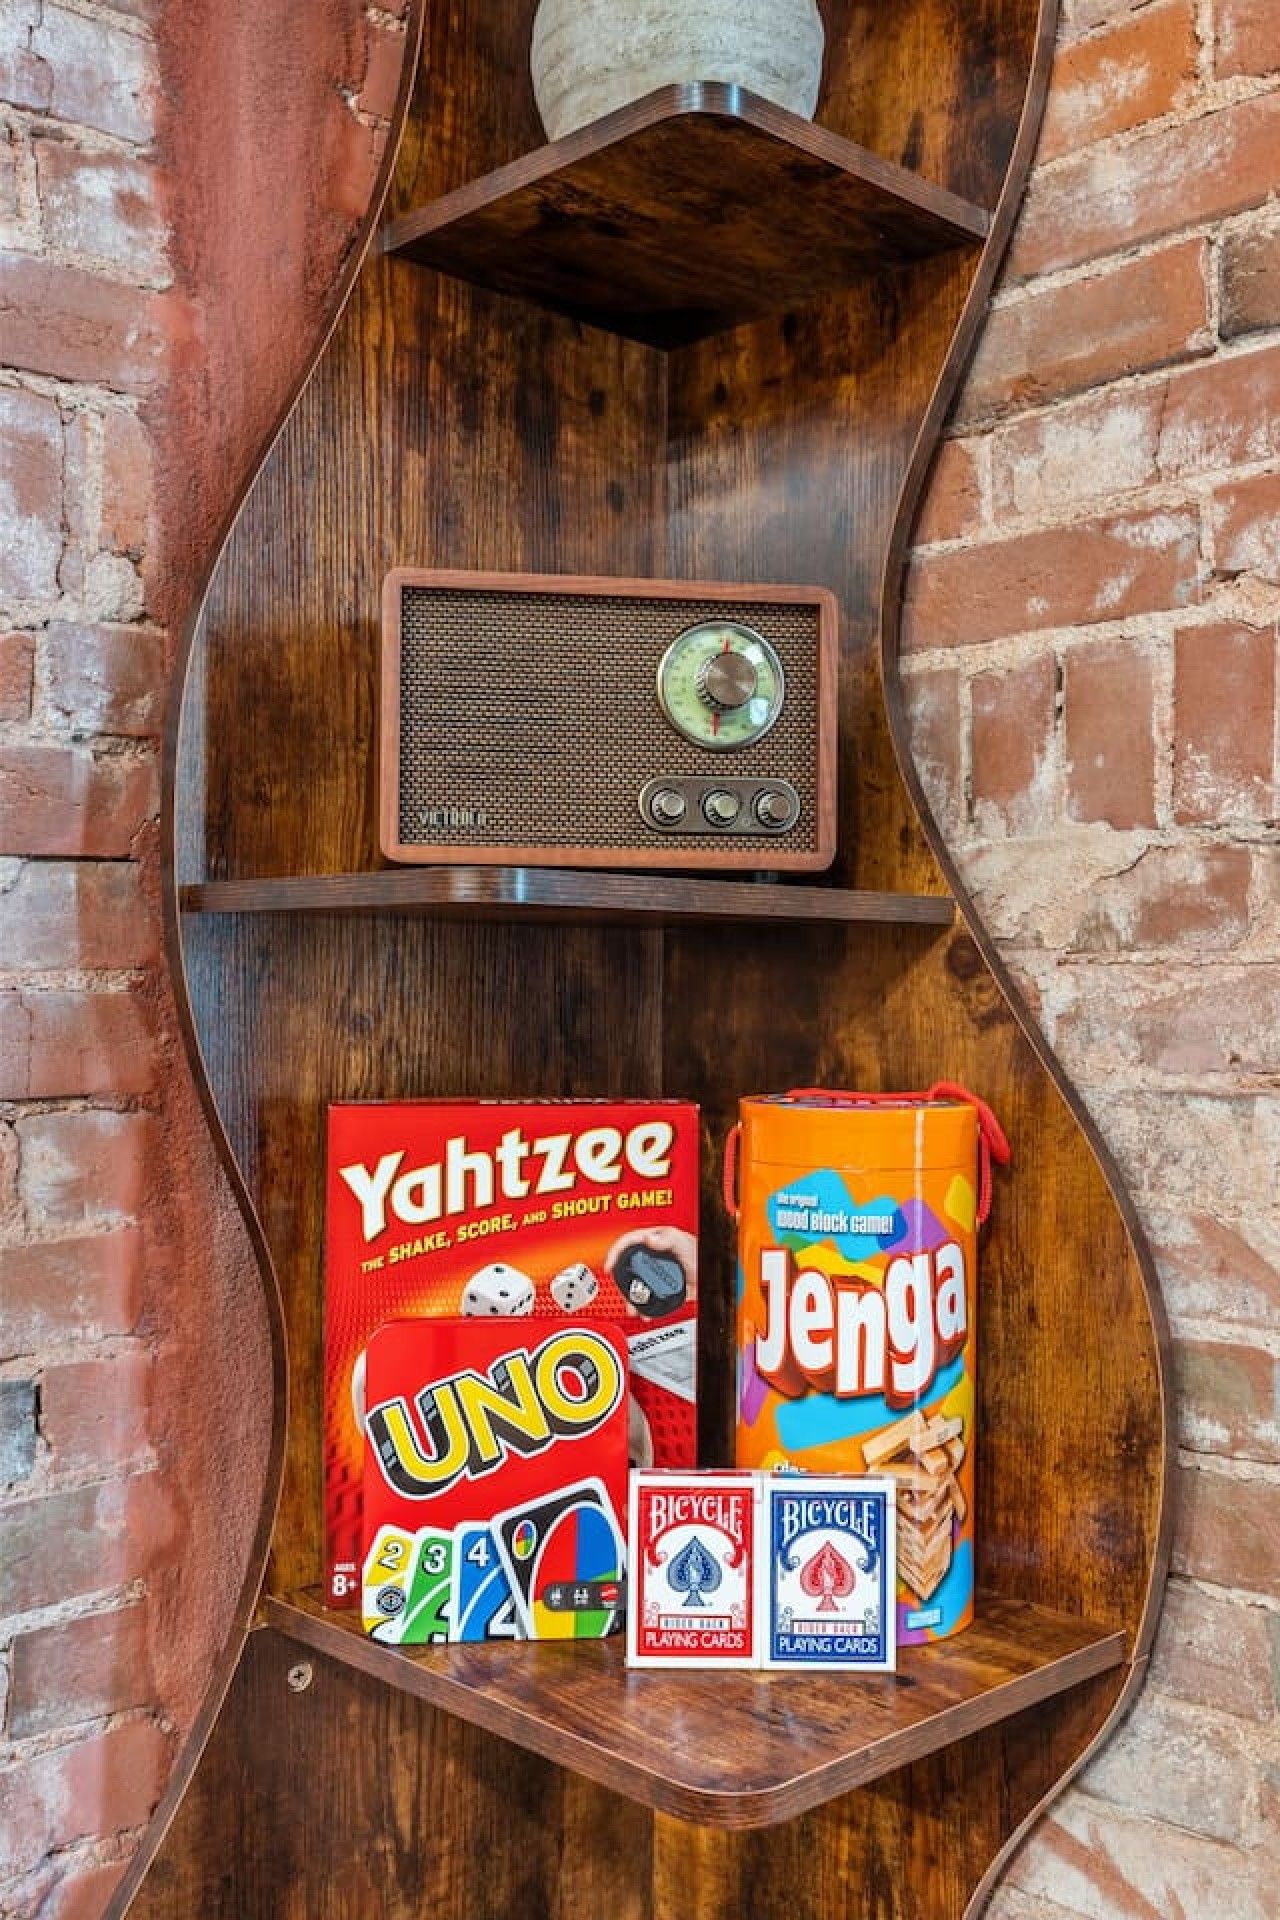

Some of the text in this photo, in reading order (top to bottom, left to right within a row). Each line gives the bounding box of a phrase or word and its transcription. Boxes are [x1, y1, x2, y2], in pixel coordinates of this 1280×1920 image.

[338, 1120, 674, 1242] Yahtzee
[361, 1189, 674, 1274] THE SHAKE, SCORE, AND SHOUT GAME!
[754, 1242, 968, 1395] Jenga
[366, 1329, 624, 1498] UNO
[649, 1494, 744, 1545] BICYCLE
[781, 1499, 877, 1550] BICYCLE
[378, 1541, 403, 1570] 2
[422, 1544, 448, 1575] 3
[467, 1537, 490, 1568] 4
[332, 1574, 358, 1597] 8+
[645, 1631, 745, 1649] PLAYING CARDS
[779, 1636, 878, 1654] PLAYING CARDS
